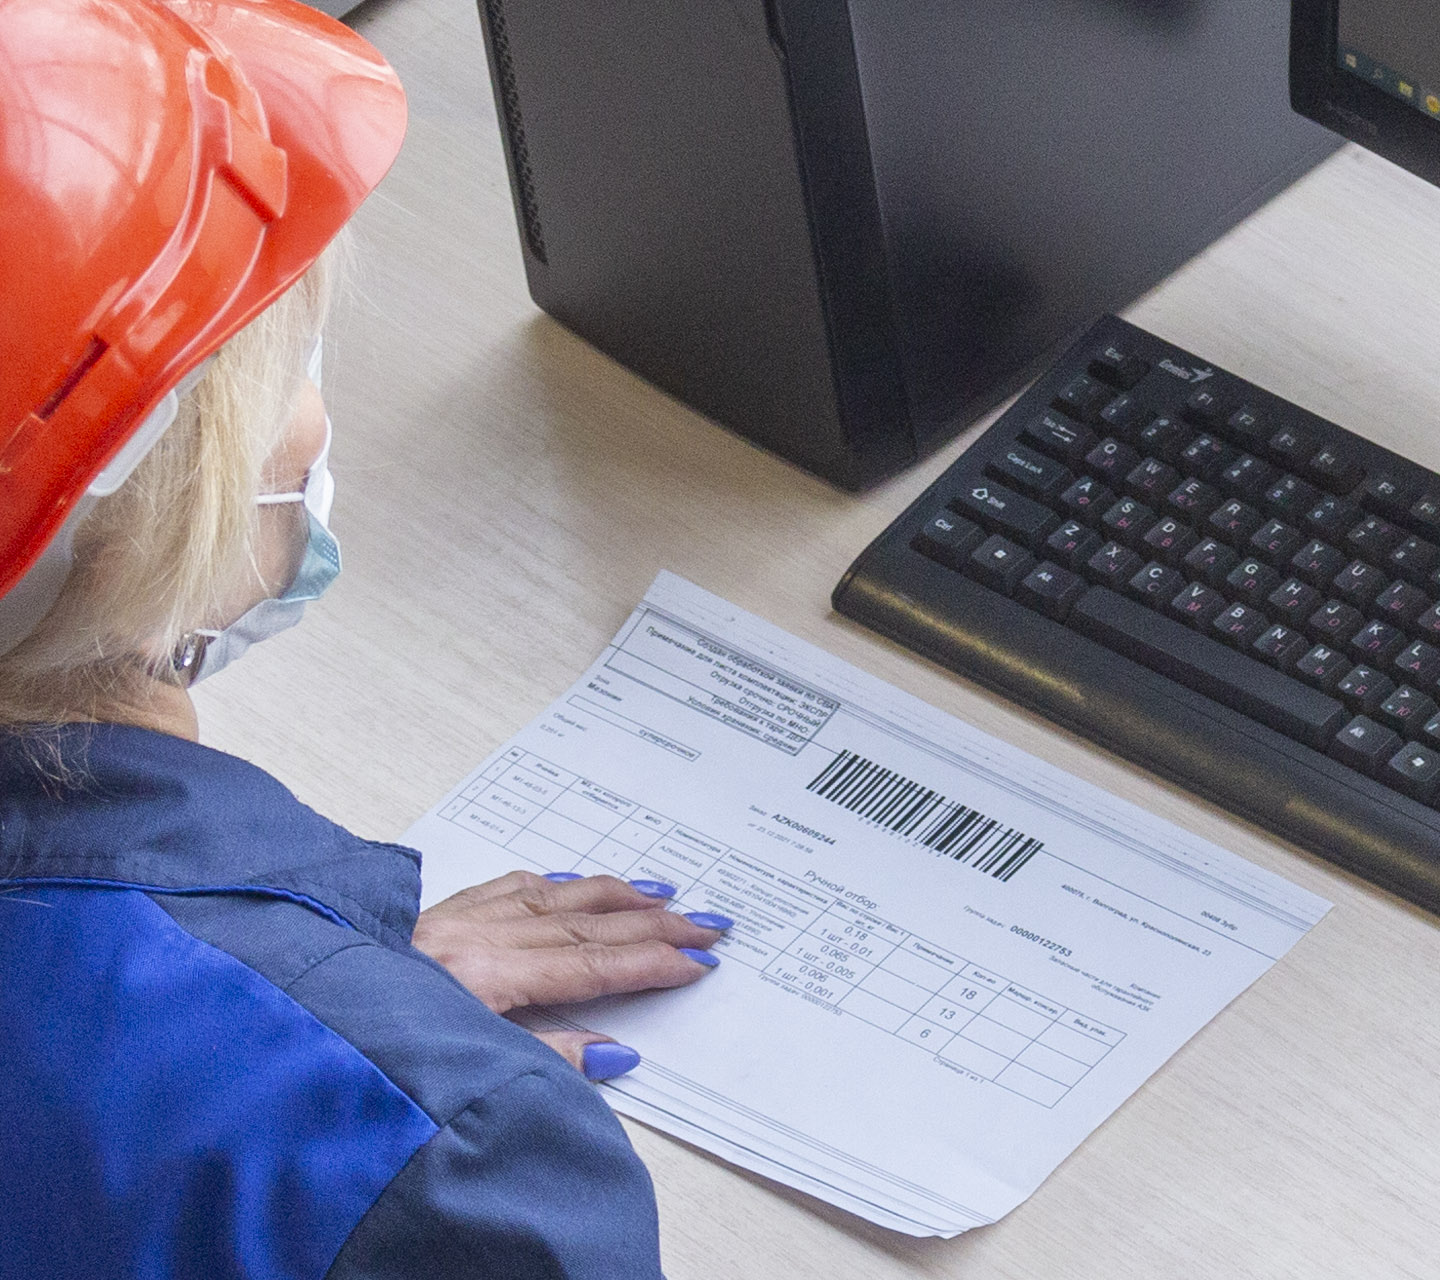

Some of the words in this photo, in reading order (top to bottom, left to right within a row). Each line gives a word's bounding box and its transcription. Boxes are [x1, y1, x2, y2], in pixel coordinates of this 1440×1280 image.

[803, 871, 846, 893] Ручной
[842, 926, 868, 940] 0,18
[1009, 925, 1072, 956] 00000122753
[819, 945, 848, 961] 0,065
[828, 934, 843, 942] шт
[849, 944, 873, 956] 0,01
[804, 953, 818, 961] шт
[825, 962, 855, 978] 0,005
[798, 966, 827, 982] 0,006
[782, 973, 797, 981] шт
[803, 982, 833, 998] 0,001
[958, 987, 977, 999] 18
[937, 1007, 956, 1019] 13
[918, 1029, 931, 1037] 6
